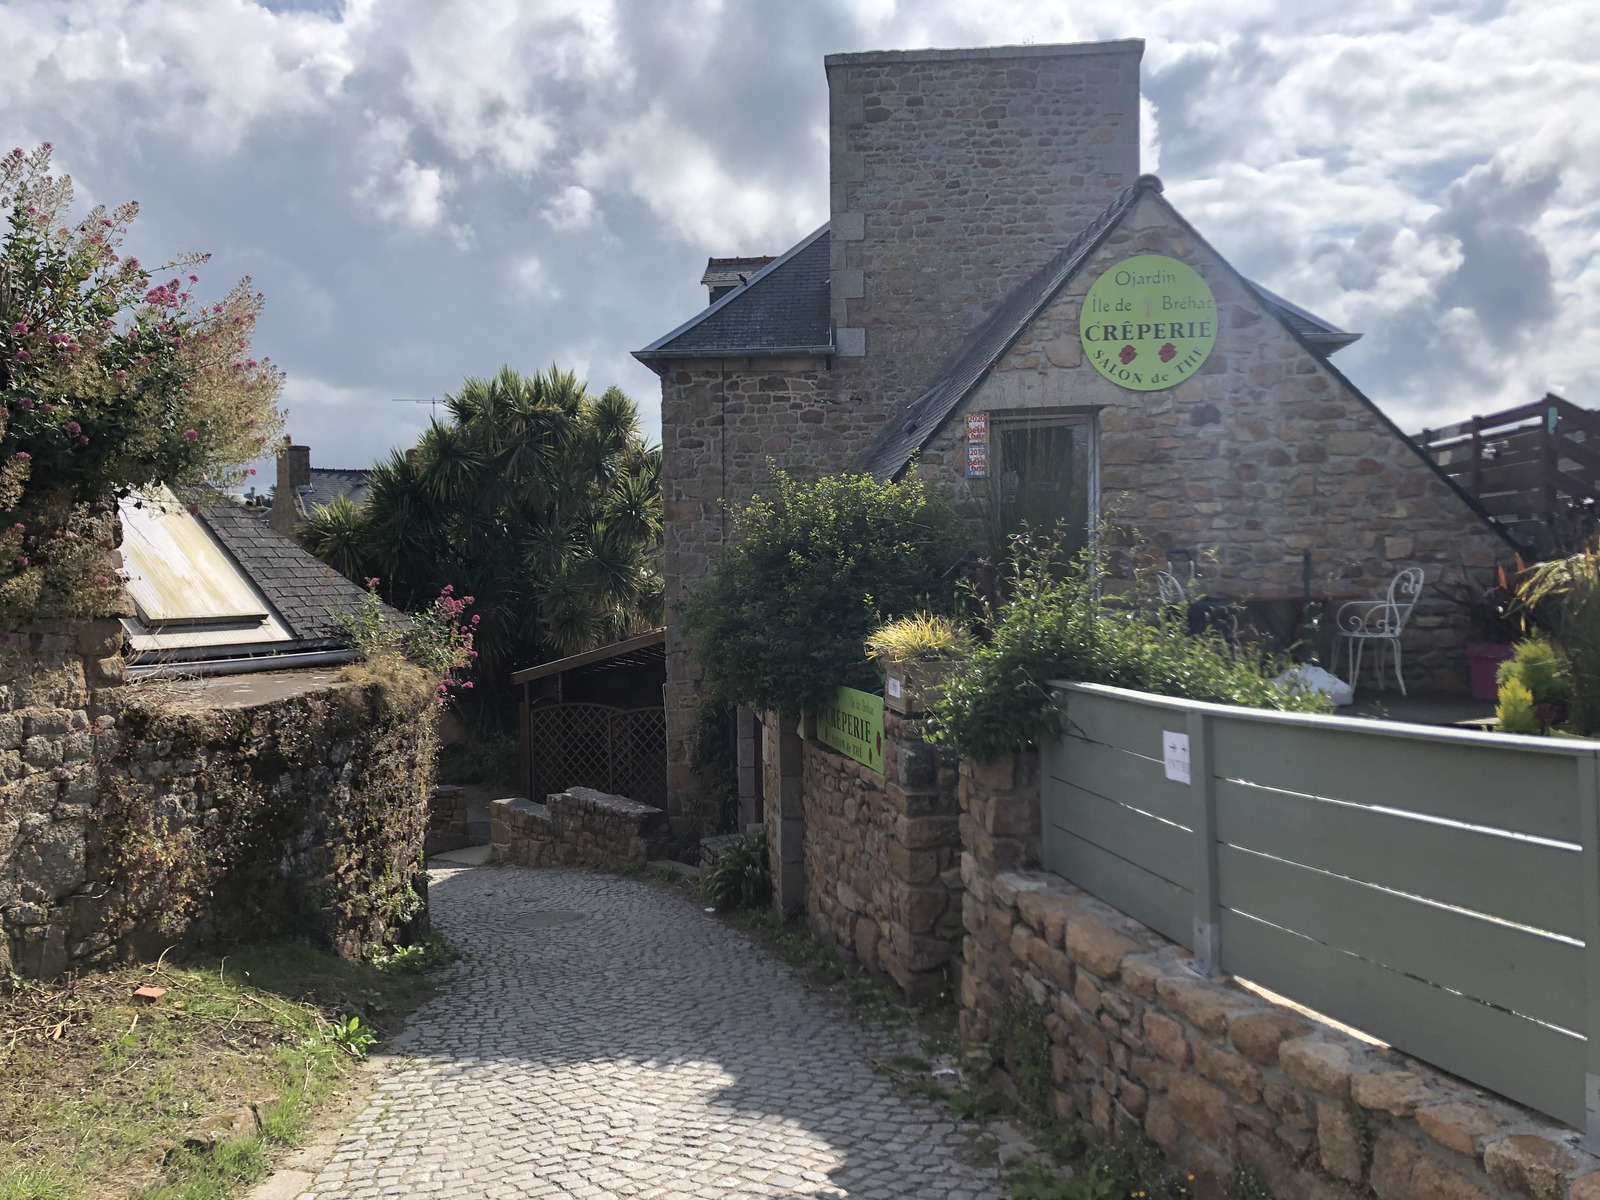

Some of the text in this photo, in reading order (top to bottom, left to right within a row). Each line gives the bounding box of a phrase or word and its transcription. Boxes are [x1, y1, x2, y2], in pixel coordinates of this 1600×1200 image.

[1115, 269, 1176, 288] Ojardin
[1092, 293, 1111, 313] Île
[1115, 297, 1132, 312] de
[1085, 320, 1212, 342] CRÊPERIE
[1092, 349, 1144, 384] SALON
[1151, 373, 1169, 384] de
[968, 415, 985, 423] 2020
[969, 448, 985, 456] 2019
